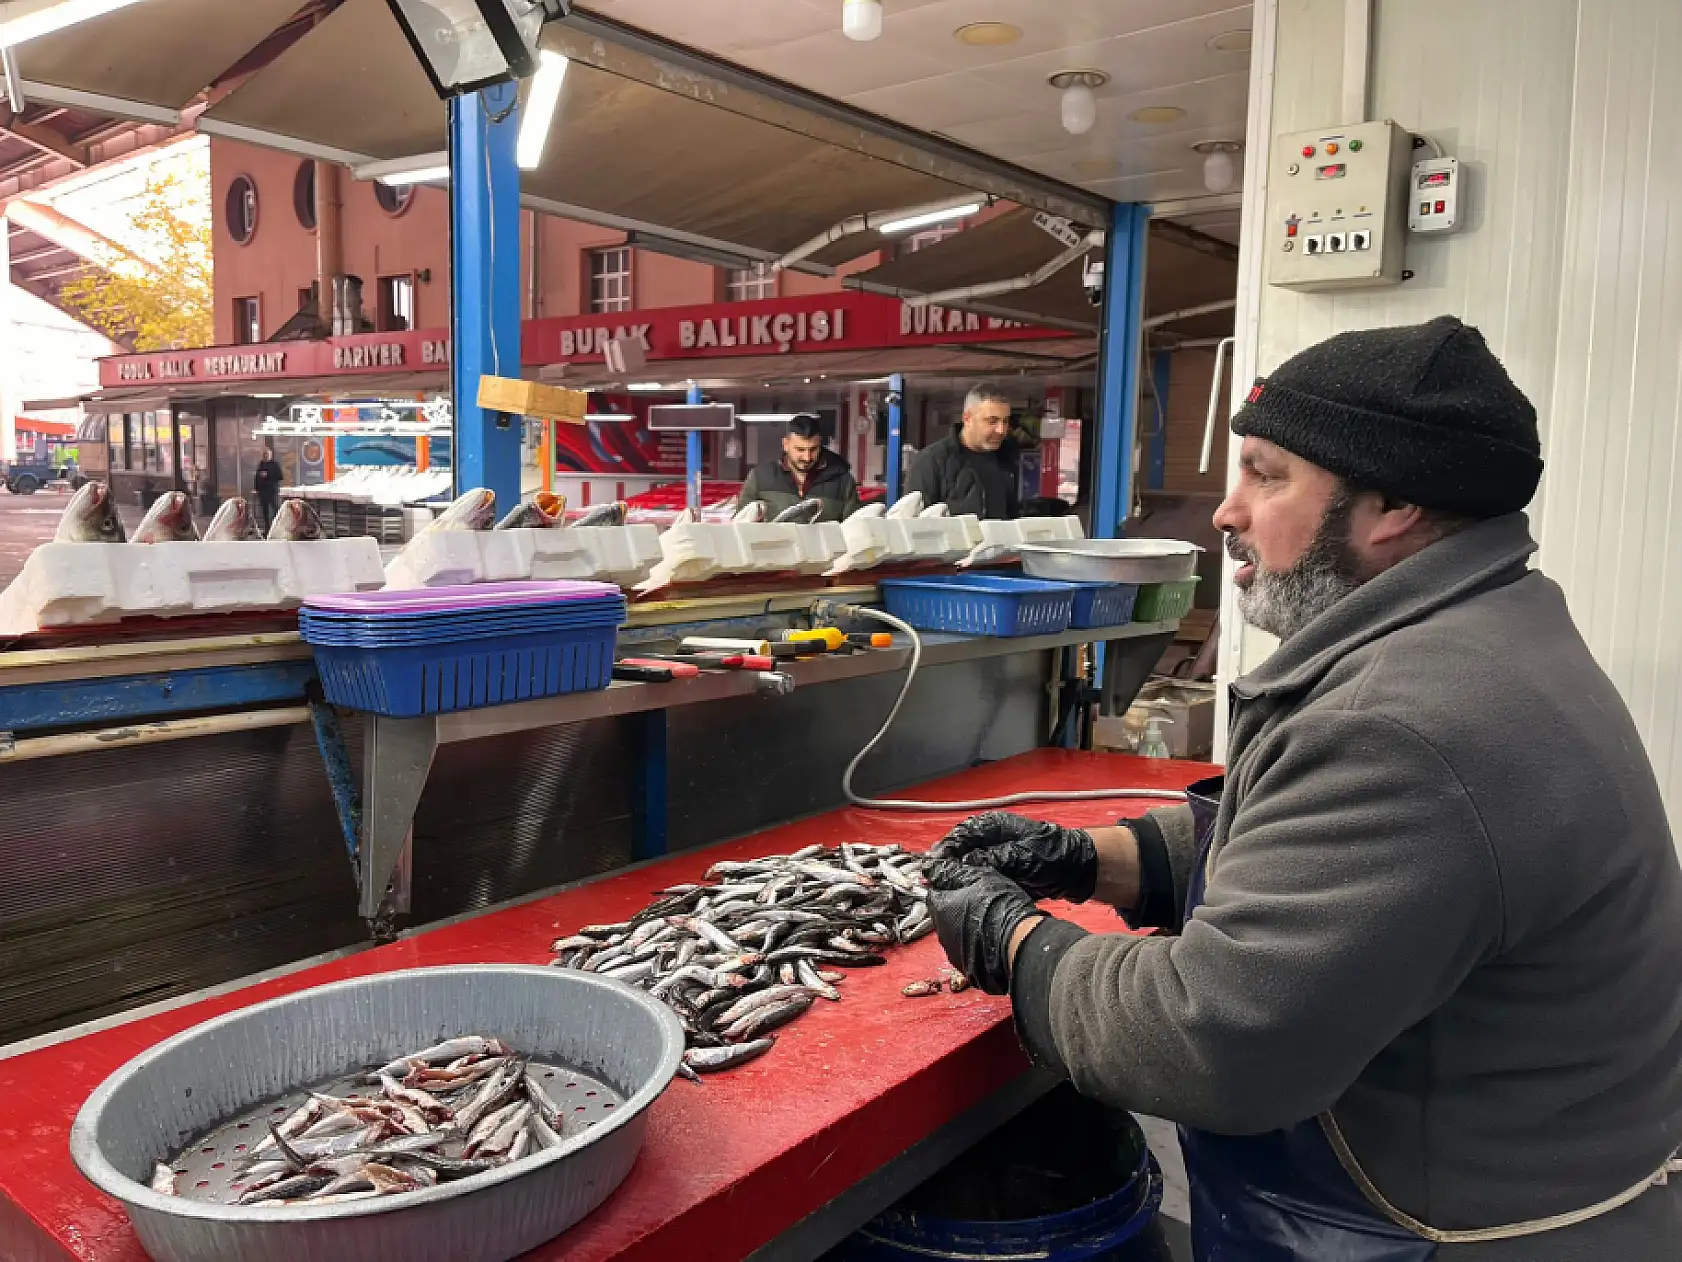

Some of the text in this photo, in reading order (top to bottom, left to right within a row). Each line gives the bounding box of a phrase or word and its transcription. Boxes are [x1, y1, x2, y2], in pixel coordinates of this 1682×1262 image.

[560, 308, 845, 356] BURAK BALIKÇISI
[204, 351, 286, 375] RESTAURANT
